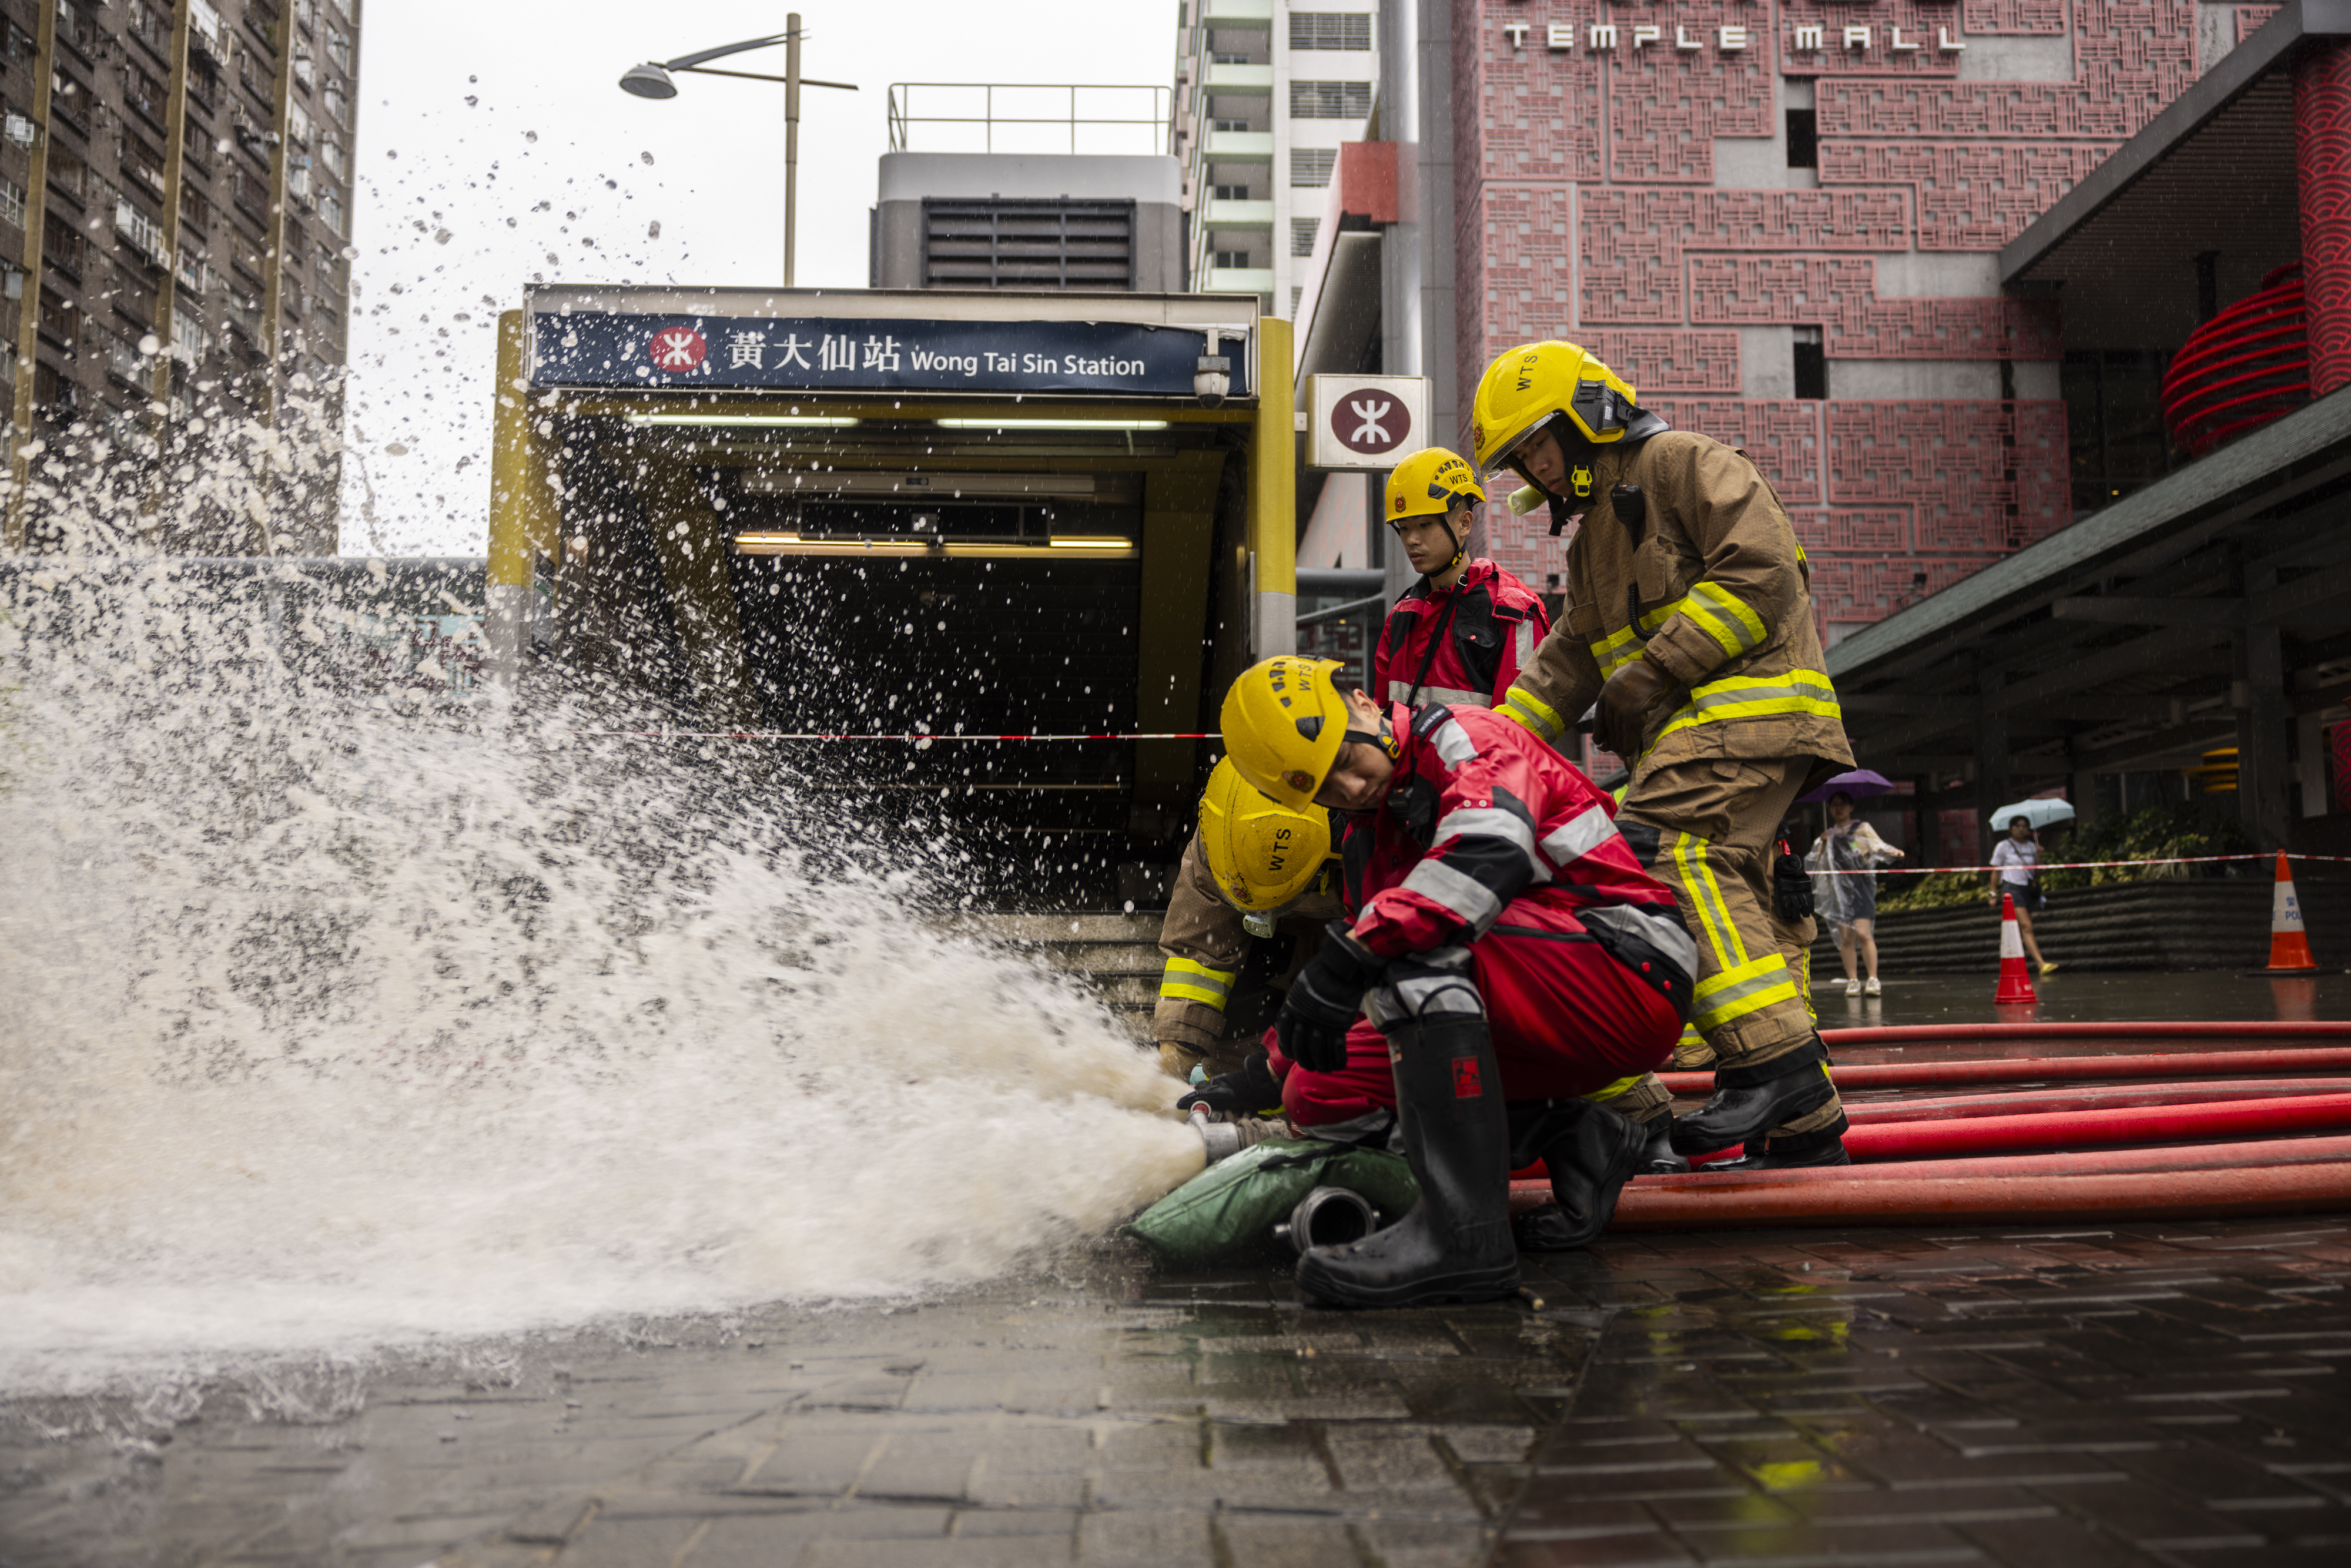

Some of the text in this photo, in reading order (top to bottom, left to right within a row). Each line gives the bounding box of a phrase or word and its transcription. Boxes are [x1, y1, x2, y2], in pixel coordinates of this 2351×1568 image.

[1505, 24, 1966, 49] TEMPLE MALL
[728, 333, 1145, 377] 黃大仙站 Wong Tai Sin Station
[1516, 356, 1538, 392] WTS
[1449, 474, 1468, 484] WTS
[1298, 665, 1312, 691] WTS
[1268, 829, 1291, 871] WTS
